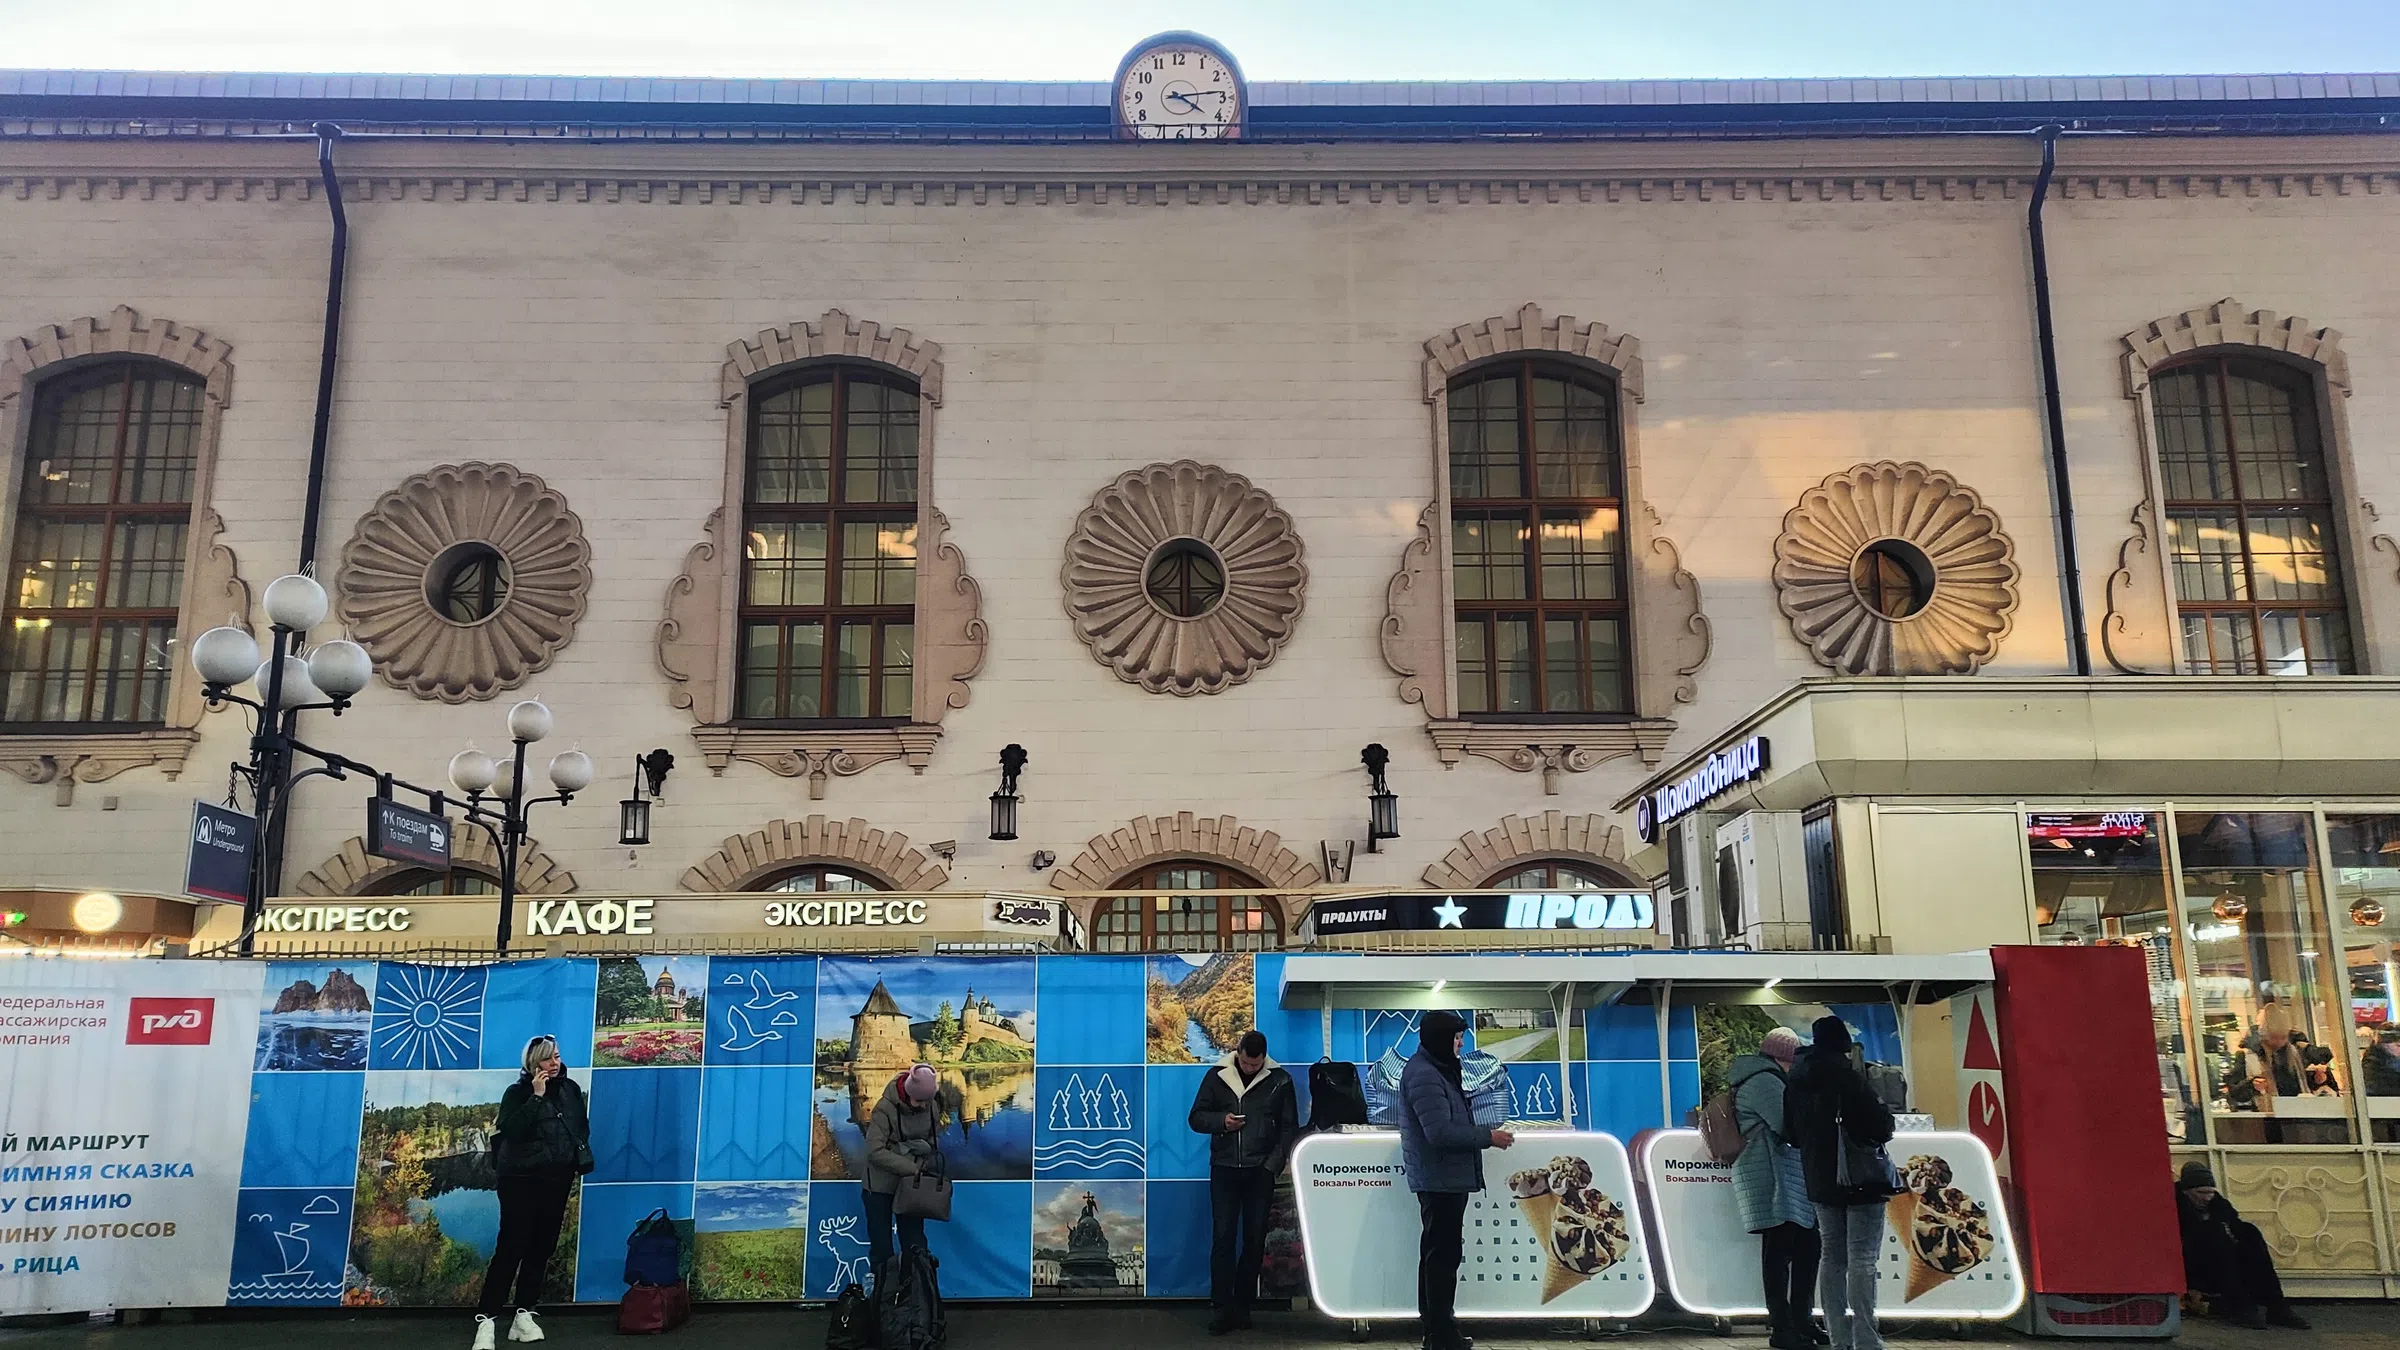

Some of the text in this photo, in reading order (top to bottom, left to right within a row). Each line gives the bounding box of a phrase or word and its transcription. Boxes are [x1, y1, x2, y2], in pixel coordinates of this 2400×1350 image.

[1153, 58, 1164, 69] 11
[1172, 54, 1185, 65] 12
[1200, 58, 1205, 69] 1
[1138, 72, 1152, 84] 10
[1213, 71, 1220, 81] 2
[1135, 91, 1143, 104] 9
[1219, 91, 1226, 103] 3
[1138, 109, 1147, 121] 8
[1214, 108, 1223, 122] 4
[1656, 735, 1760, 824] Шоколадница
[214, 819, 236, 838] Метро
[389, 811, 428, 835] К поездам
[389, 828, 397, 840] To
[212, 837, 245, 853] Underground
[526, 899, 655, 935] КАФЕ
[764, 900, 927, 926] ЭКСПРЕСС
[1321, 908, 1388, 925] ПРОДУКТЫ
[0, 997, 105, 1012] едеральная
[0, 1034, 70, 1046] мпания
[26, 1134, 149, 1152] МАРШРУТ
[100, 1162, 195, 1180] СКАЗКА
[1312, 1163, 1391, 1176] Мороженое
[1313, 1179, 1392, 1188] Вокзалы России
[1665, 1174, 1710, 1183] Вокзалы
[24, 1193, 132, 1212] СИЯНИЮ
[63, 1222, 177, 1241] ЛОТОСОВ
[13, 1255, 80, 1276] РИЦА
